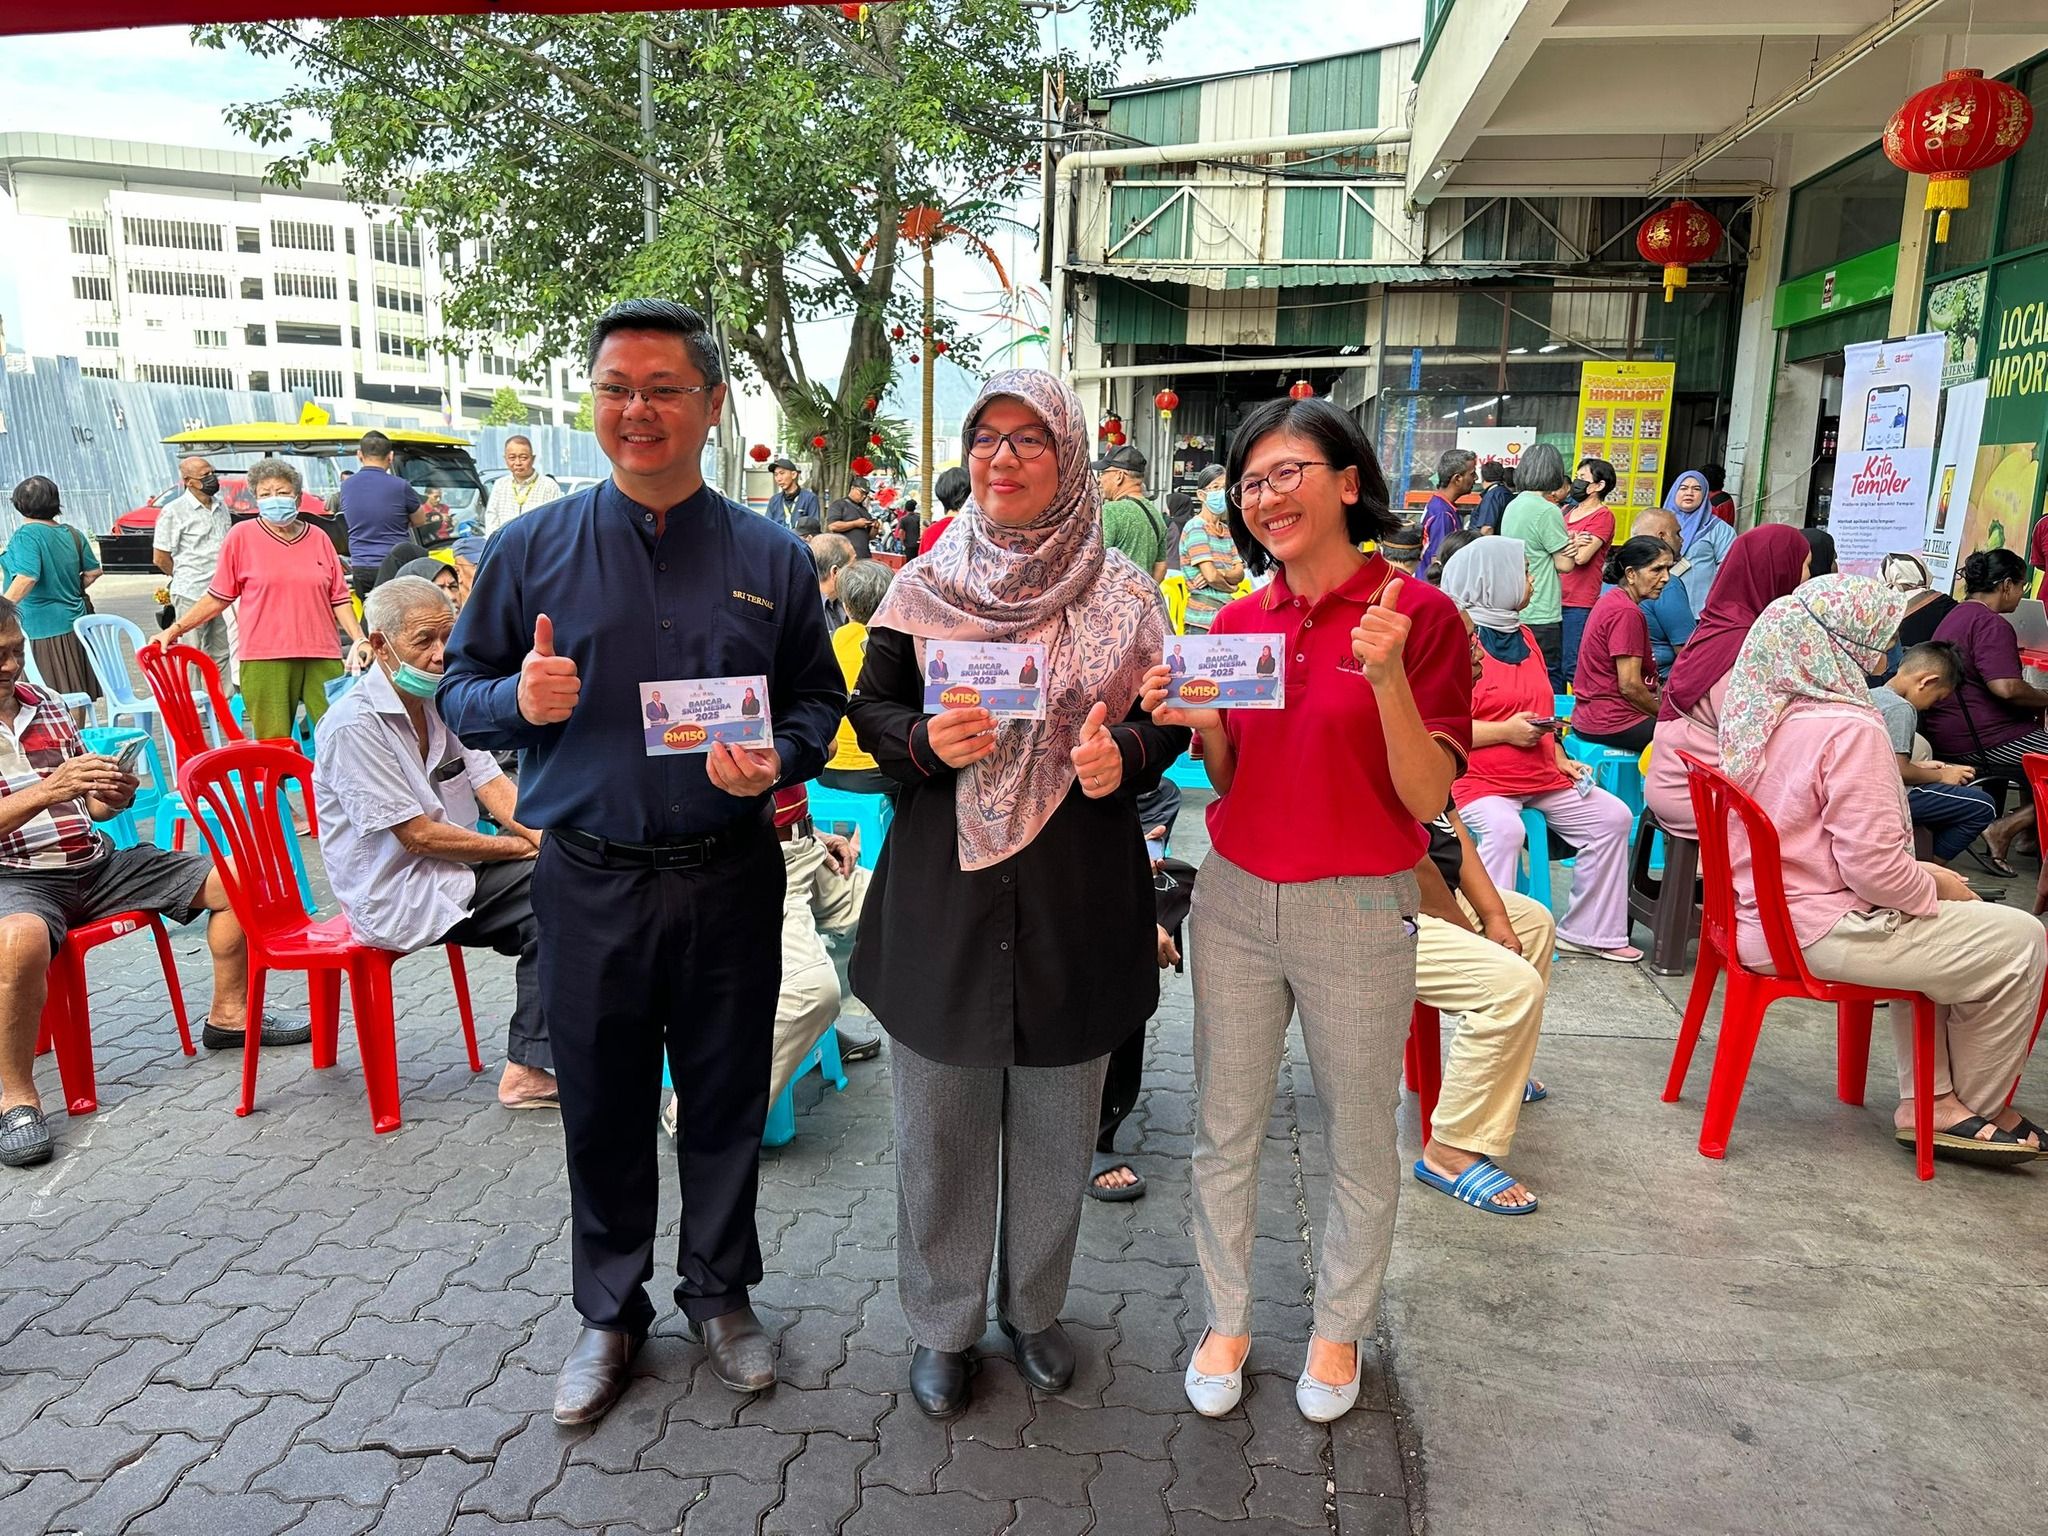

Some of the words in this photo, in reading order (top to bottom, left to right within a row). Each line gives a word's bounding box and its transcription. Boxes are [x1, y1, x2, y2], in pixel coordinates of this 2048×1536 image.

[1584, 375, 1672, 389] PROMOTION
[1589, 388, 1665, 401] HIGHLIGHT
[1863, 454, 1892, 479] Kita
[1851, 470, 1912, 502] Templer
[732, 590, 746, 600] SRI
[1205, 654, 1239, 663] BAUCAR
[1198, 662, 1218, 670] SKIM
[1218, 660, 1247, 669] MESRA
[1210, 668, 1234, 677] 2025
[972, 676, 997, 685] 2025
[1179, 686, 1219, 697] RM150
[688, 698, 722, 708] BAUCAR
[940, 693, 980, 704] RM150
[681, 706, 702, 716] SKIM
[703, 702, 732, 713] MESRA
[695, 711, 720, 721] 2025
[663, 730, 707, 743] RM150
